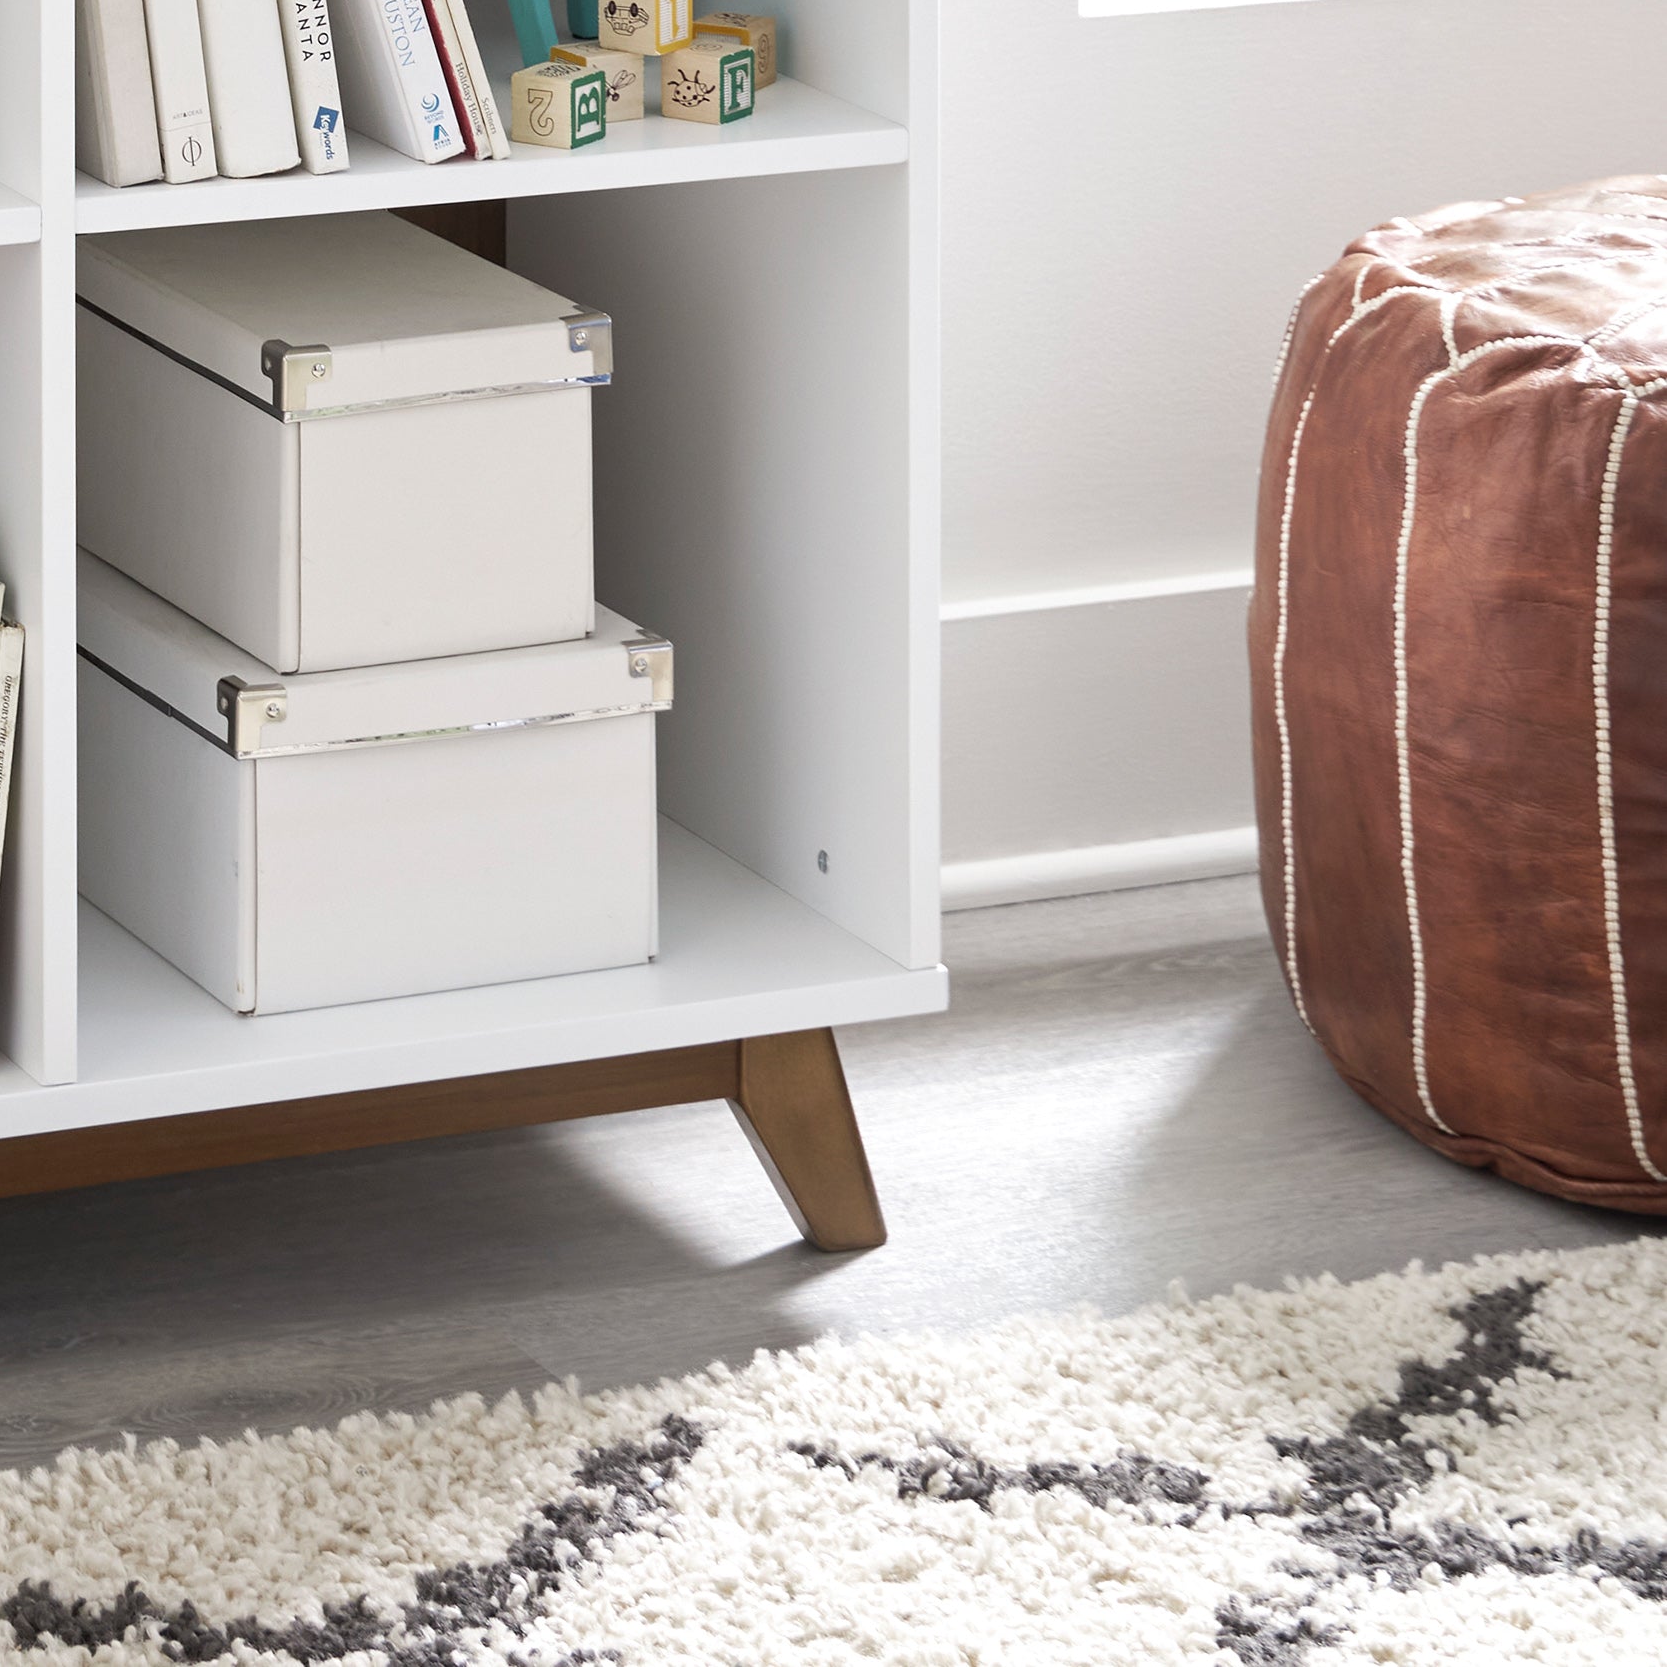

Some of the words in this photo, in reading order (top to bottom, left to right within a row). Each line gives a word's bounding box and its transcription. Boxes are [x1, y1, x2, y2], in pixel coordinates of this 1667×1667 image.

[455, 61, 473, 102] Holiday
[467, 101, 484, 137] House
[577, 86, 600, 132] B
[727, 62, 749, 112] F
[527, 88, 554, 137] 2
